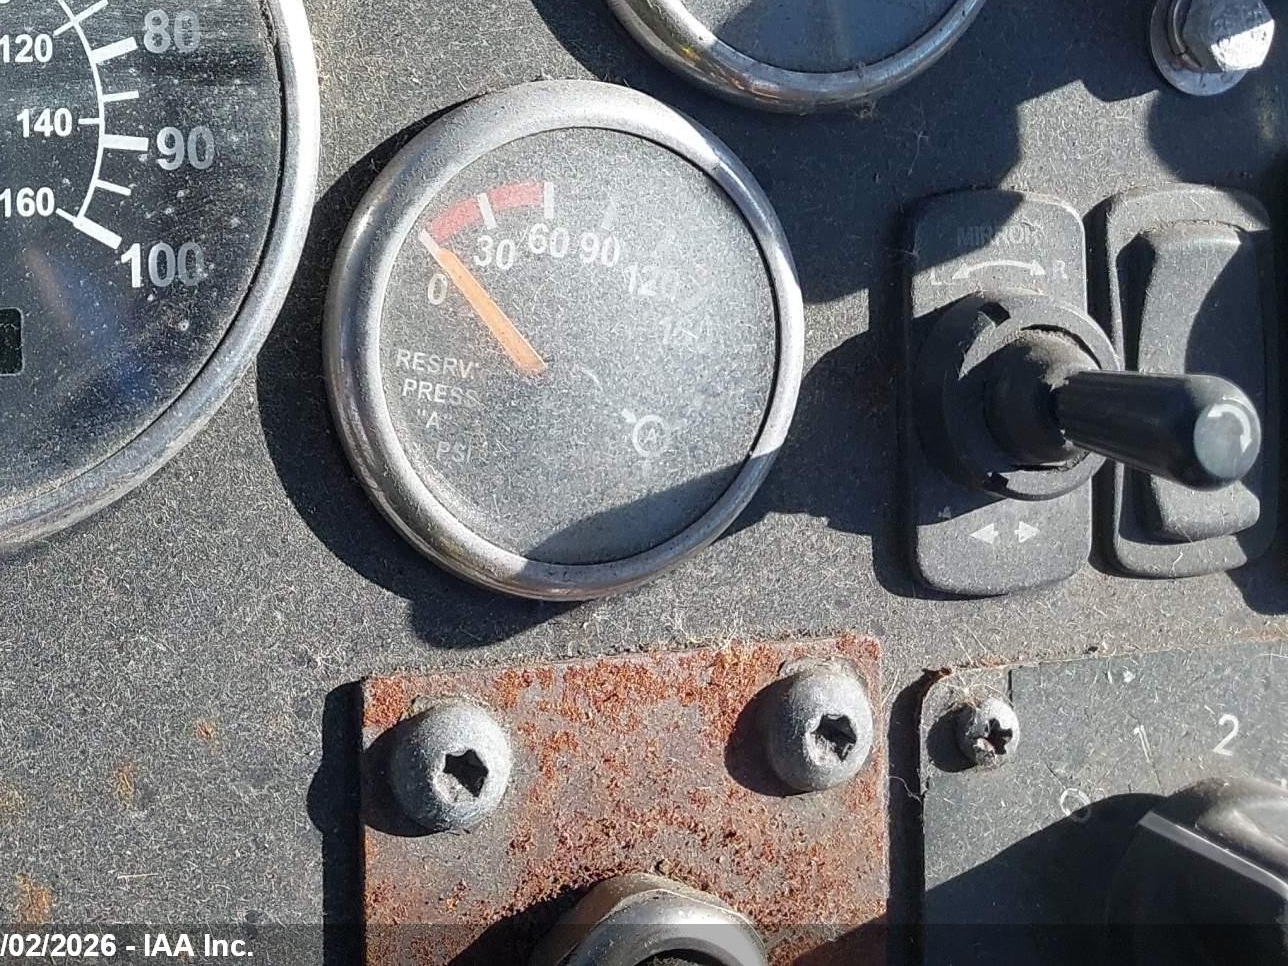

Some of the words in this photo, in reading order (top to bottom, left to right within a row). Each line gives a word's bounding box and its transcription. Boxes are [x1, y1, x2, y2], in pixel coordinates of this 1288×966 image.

[143, 10, 200, 54] 80
[15, 109, 72, 137] 140
[156, 126, 213, 169] 90
[474, 235, 517, 271] 30
[527, 222, 570, 259] 60
[580, 232, 621, 267] 90
[120, 243, 205, 287] 100
[427, 273, 449, 306] 0
[1212, 714, 1239, 756] 2
